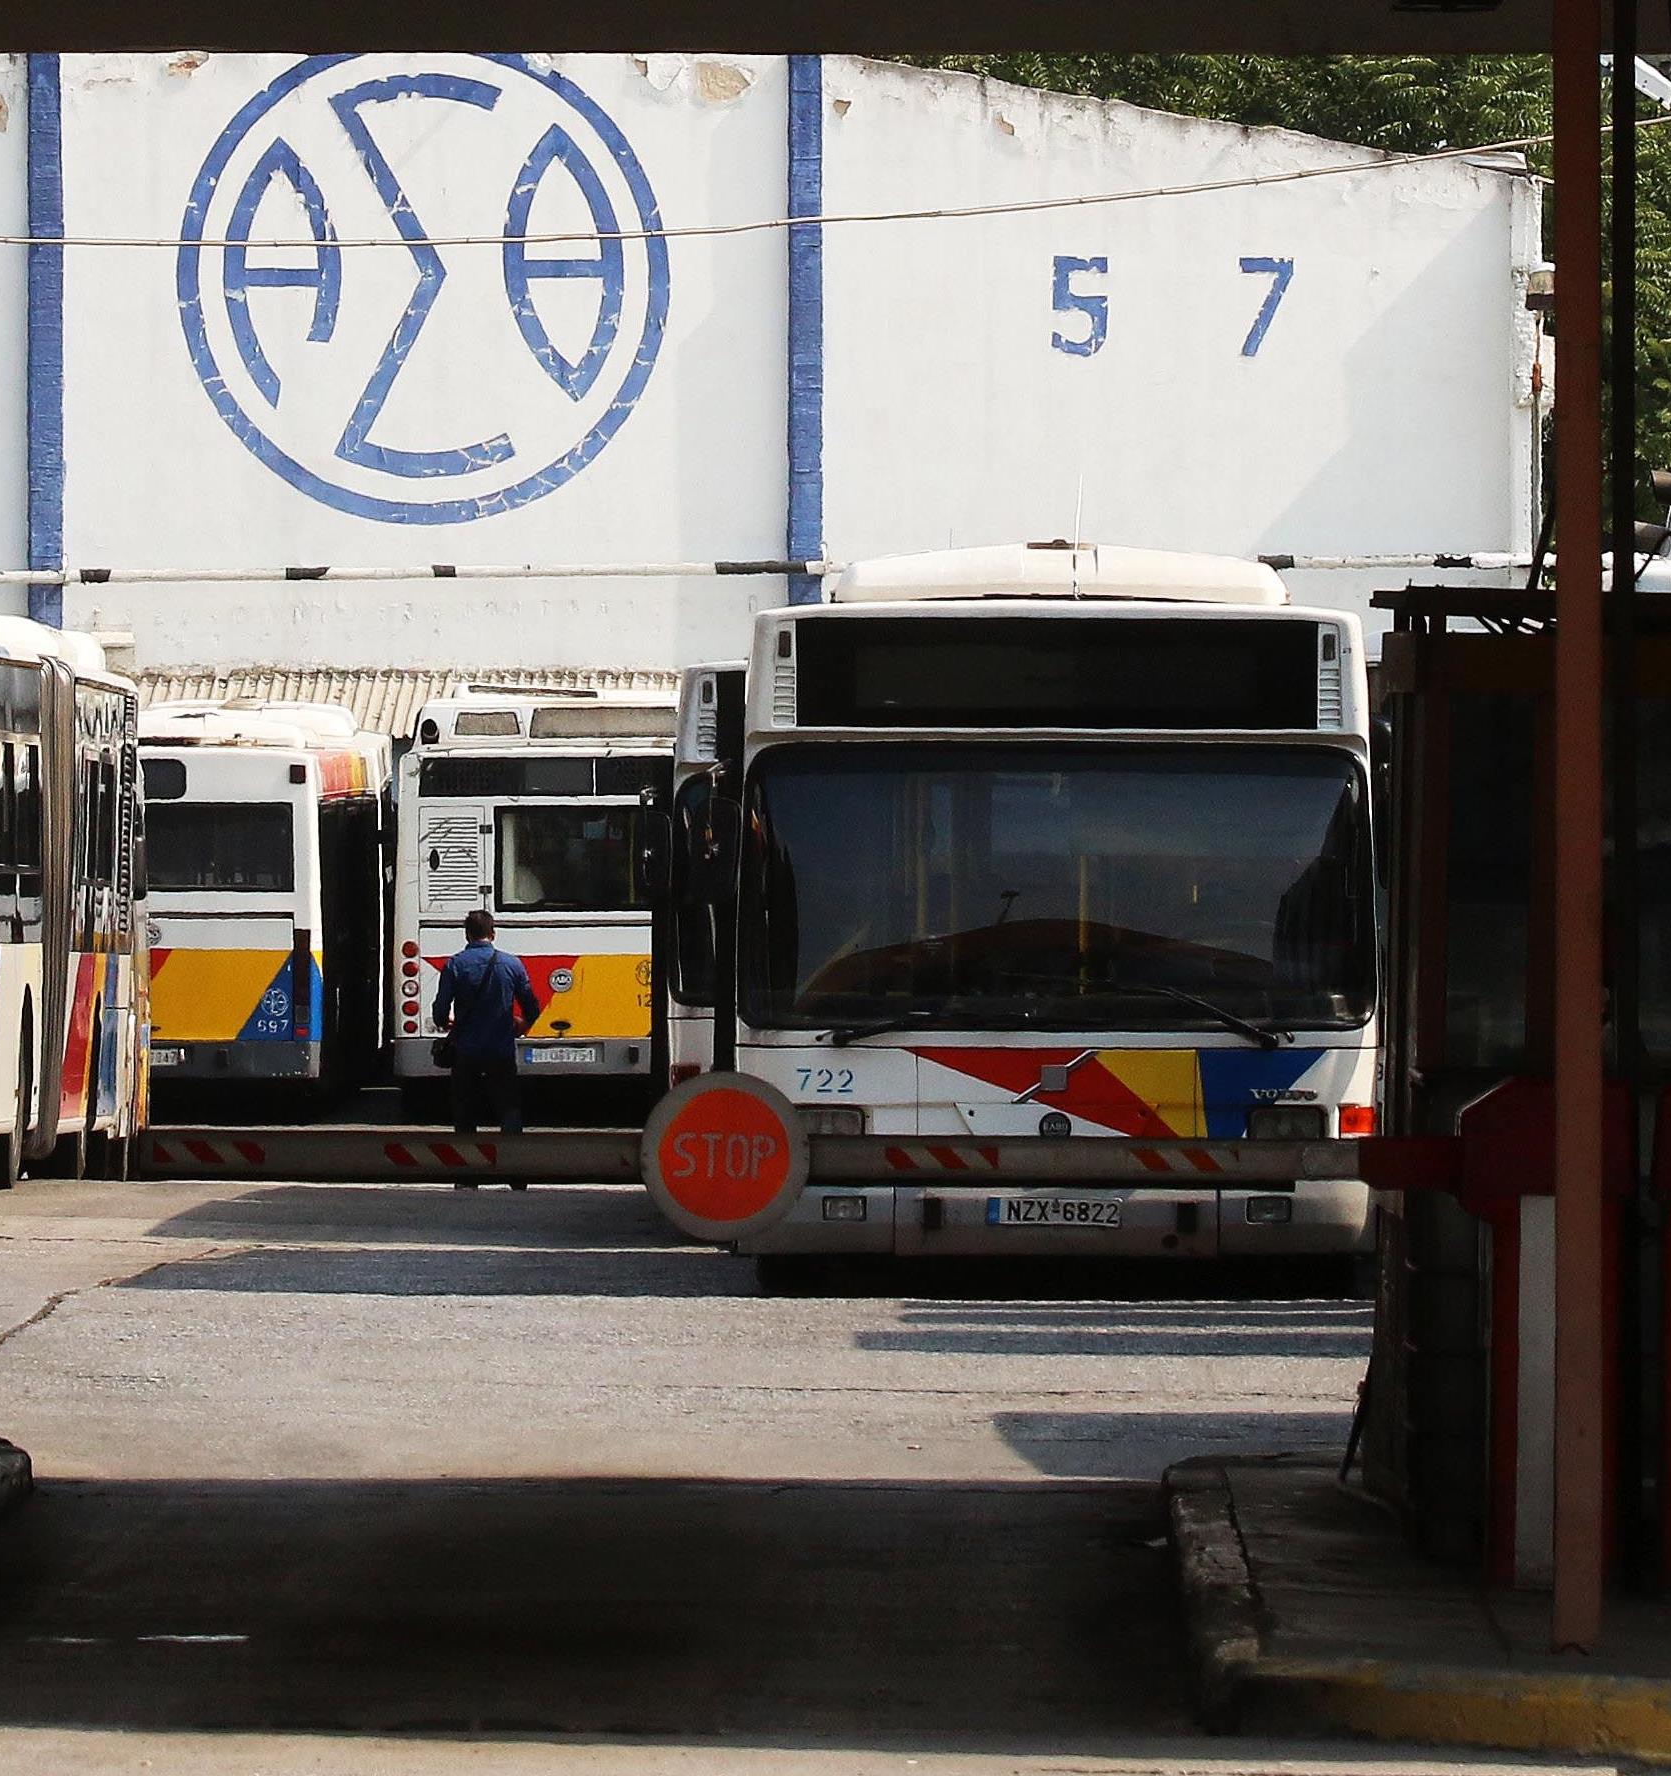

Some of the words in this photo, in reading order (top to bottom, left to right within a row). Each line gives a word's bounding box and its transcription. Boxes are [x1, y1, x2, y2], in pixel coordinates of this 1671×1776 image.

[1051, 255, 1108, 357] 5
[1238, 256, 1294, 357] 7
[796, 1068, 854, 1093] 722
[672, 1131, 777, 1180] STOP
